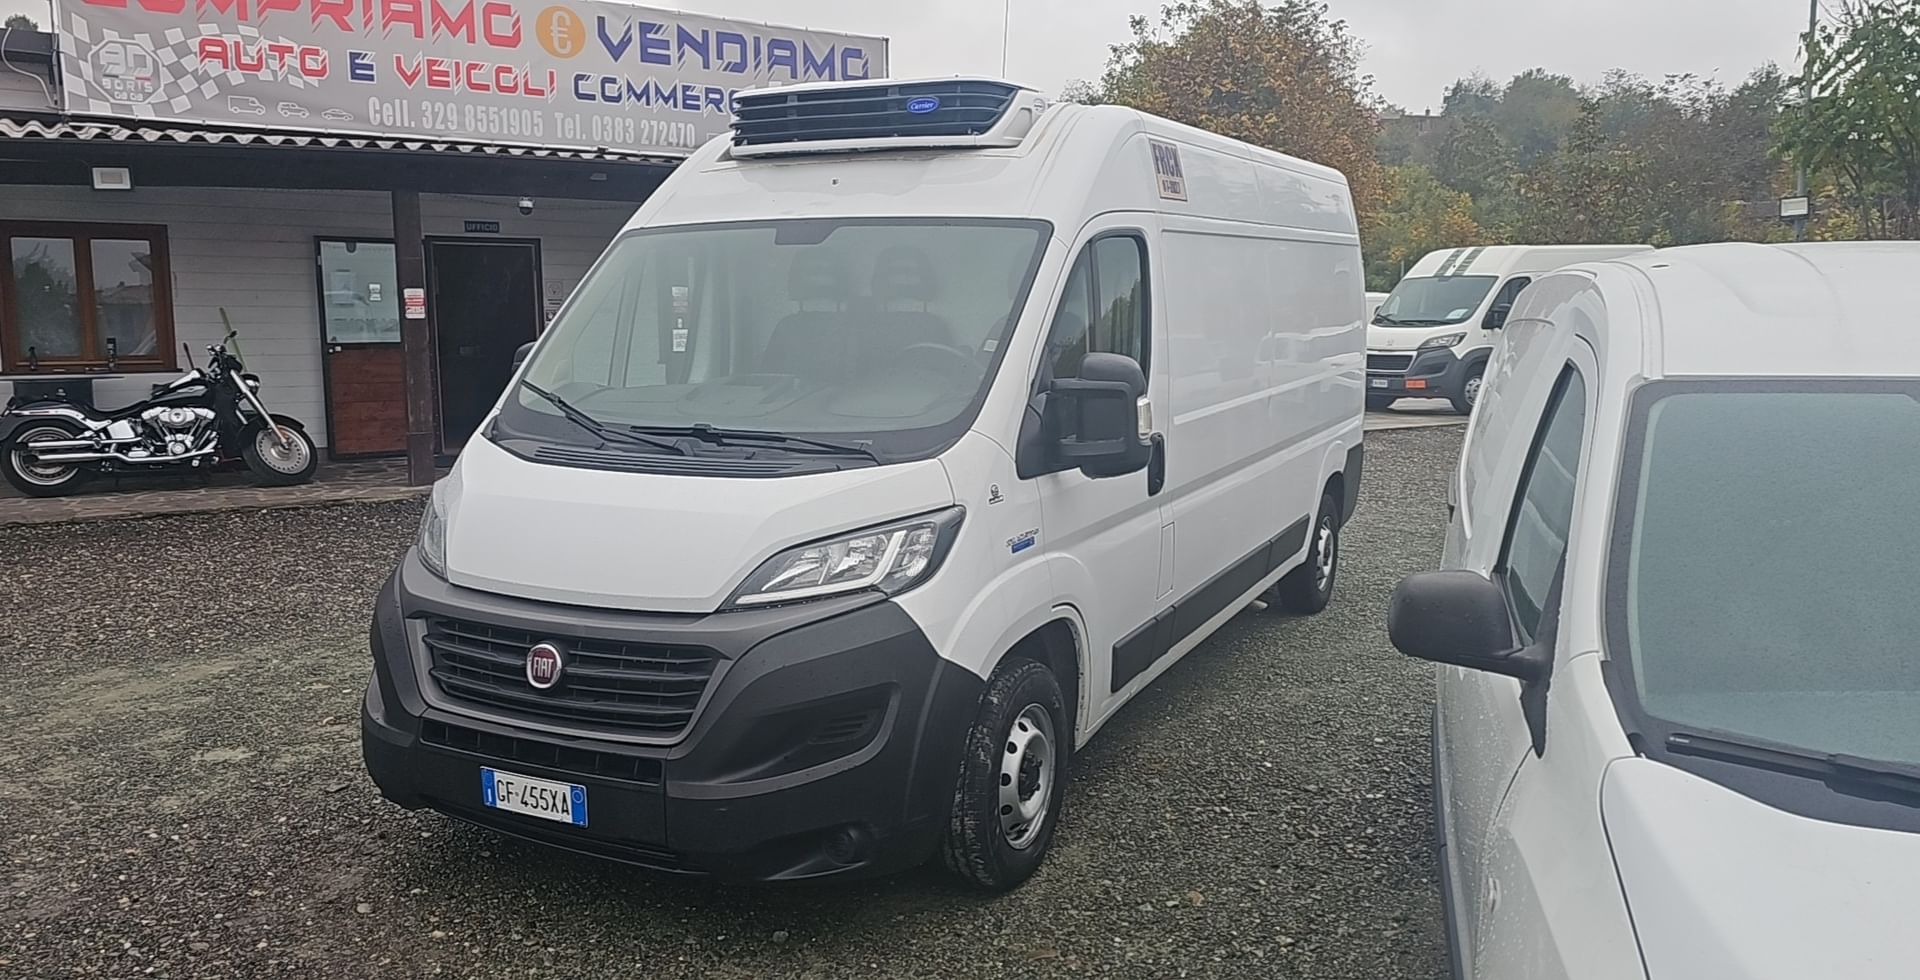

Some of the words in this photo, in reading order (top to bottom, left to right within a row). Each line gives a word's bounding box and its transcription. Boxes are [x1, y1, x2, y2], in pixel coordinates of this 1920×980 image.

[198, 37, 329, 80] AUTO
[347, 50, 376, 84] E
[393, 52, 557, 102] VEICOLI
[596, 15, 869, 81] VENDIAMO
[368, 96, 416, 128] Cell.
[420, 101, 458, 130] 329
[464, 104, 543, 137] 8551905
[554, 112, 586, 141] Tel.
[592, 114, 635, 145] 0383
[640, 119, 696, 148] 272470
[466, 223, 498, 231] UFFICIO
[533, 656, 554, 679] FIAT
